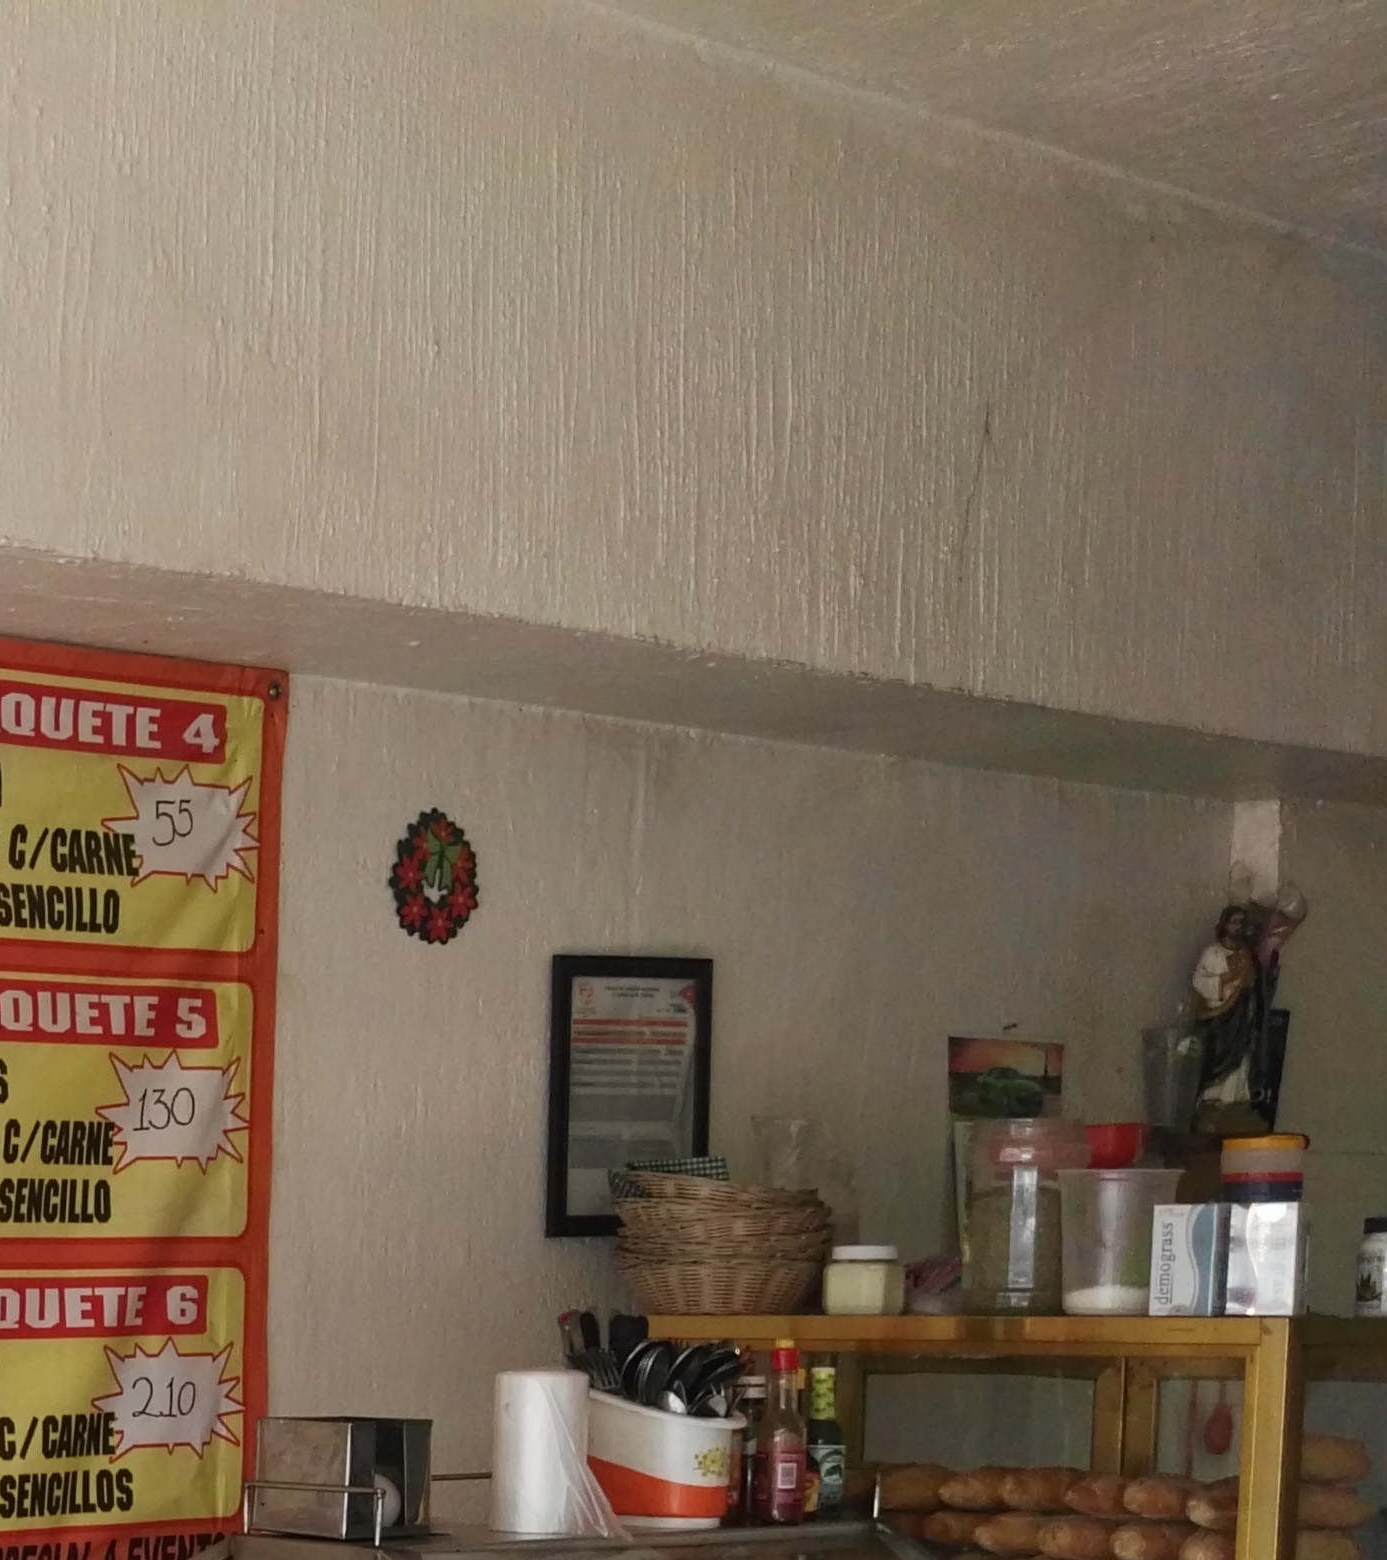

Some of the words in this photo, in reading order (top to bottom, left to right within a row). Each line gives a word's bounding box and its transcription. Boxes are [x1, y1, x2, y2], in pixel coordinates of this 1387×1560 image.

[182, 713, 221, 754] 4
[151, 798, 194, 847] 55
[8, 824, 141, 878] C/CARNE
[175, 999, 207, 1040] 5
[133, 1087, 196, 1132] 130
[3, 1118, 115, 1166] C/CARNE
[1153, 1222, 1176, 1306] demograss
[166, 1285, 199, 1326] 6
[131, 1376, 197, 1418] 210
[0, 1468, 134, 1519] SENCILLOS
